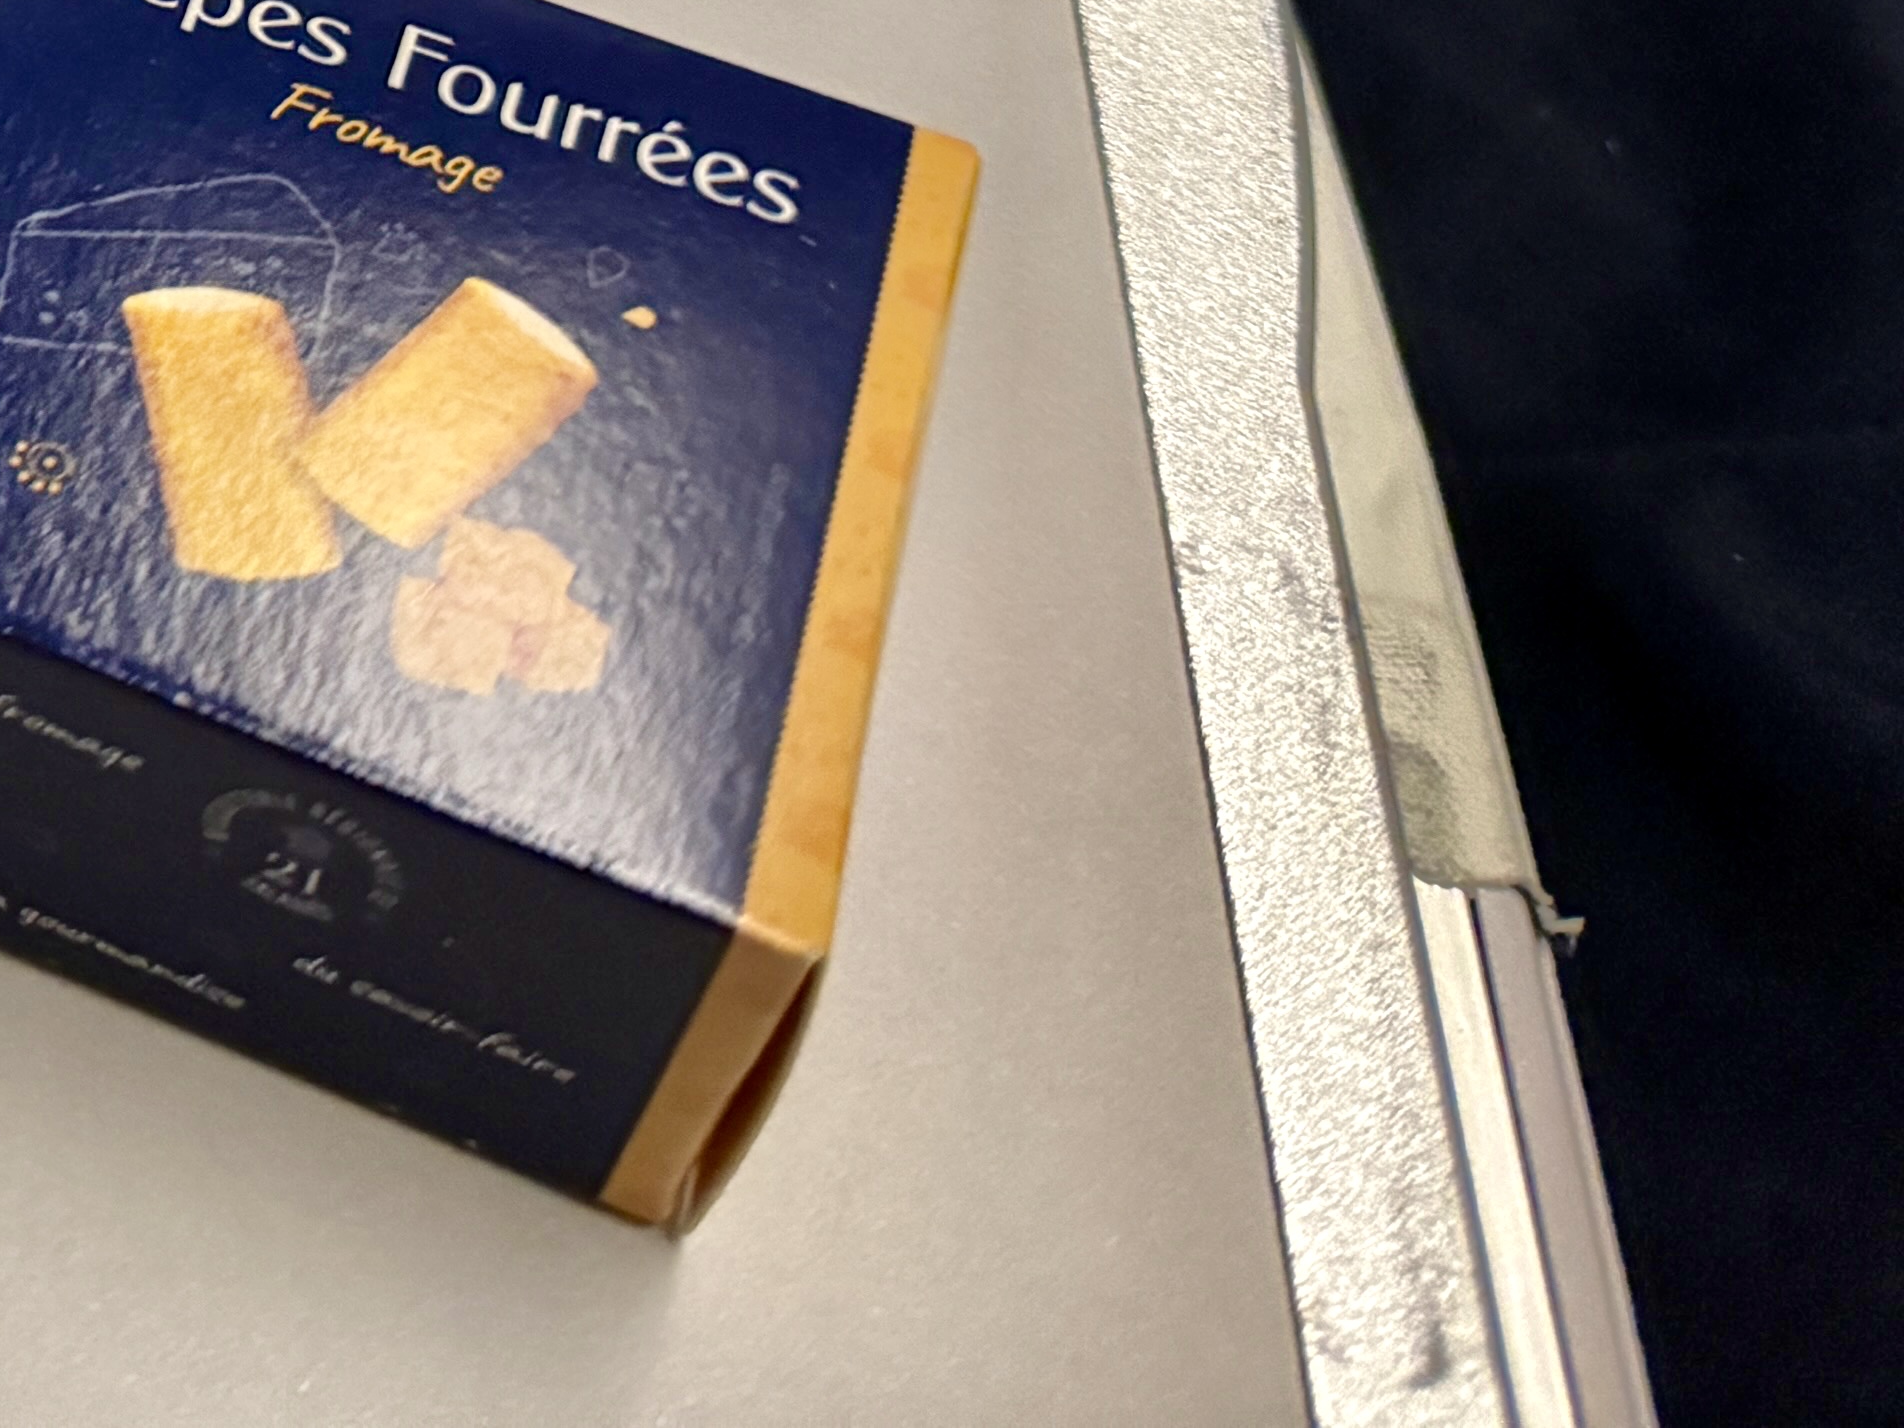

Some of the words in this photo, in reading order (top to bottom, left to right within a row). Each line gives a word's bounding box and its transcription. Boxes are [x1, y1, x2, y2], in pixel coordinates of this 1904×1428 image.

[269, 81, 506, 194] Fromage
[386, 22, 801, 225] Fourrées
[291, 954, 340, 986] du
